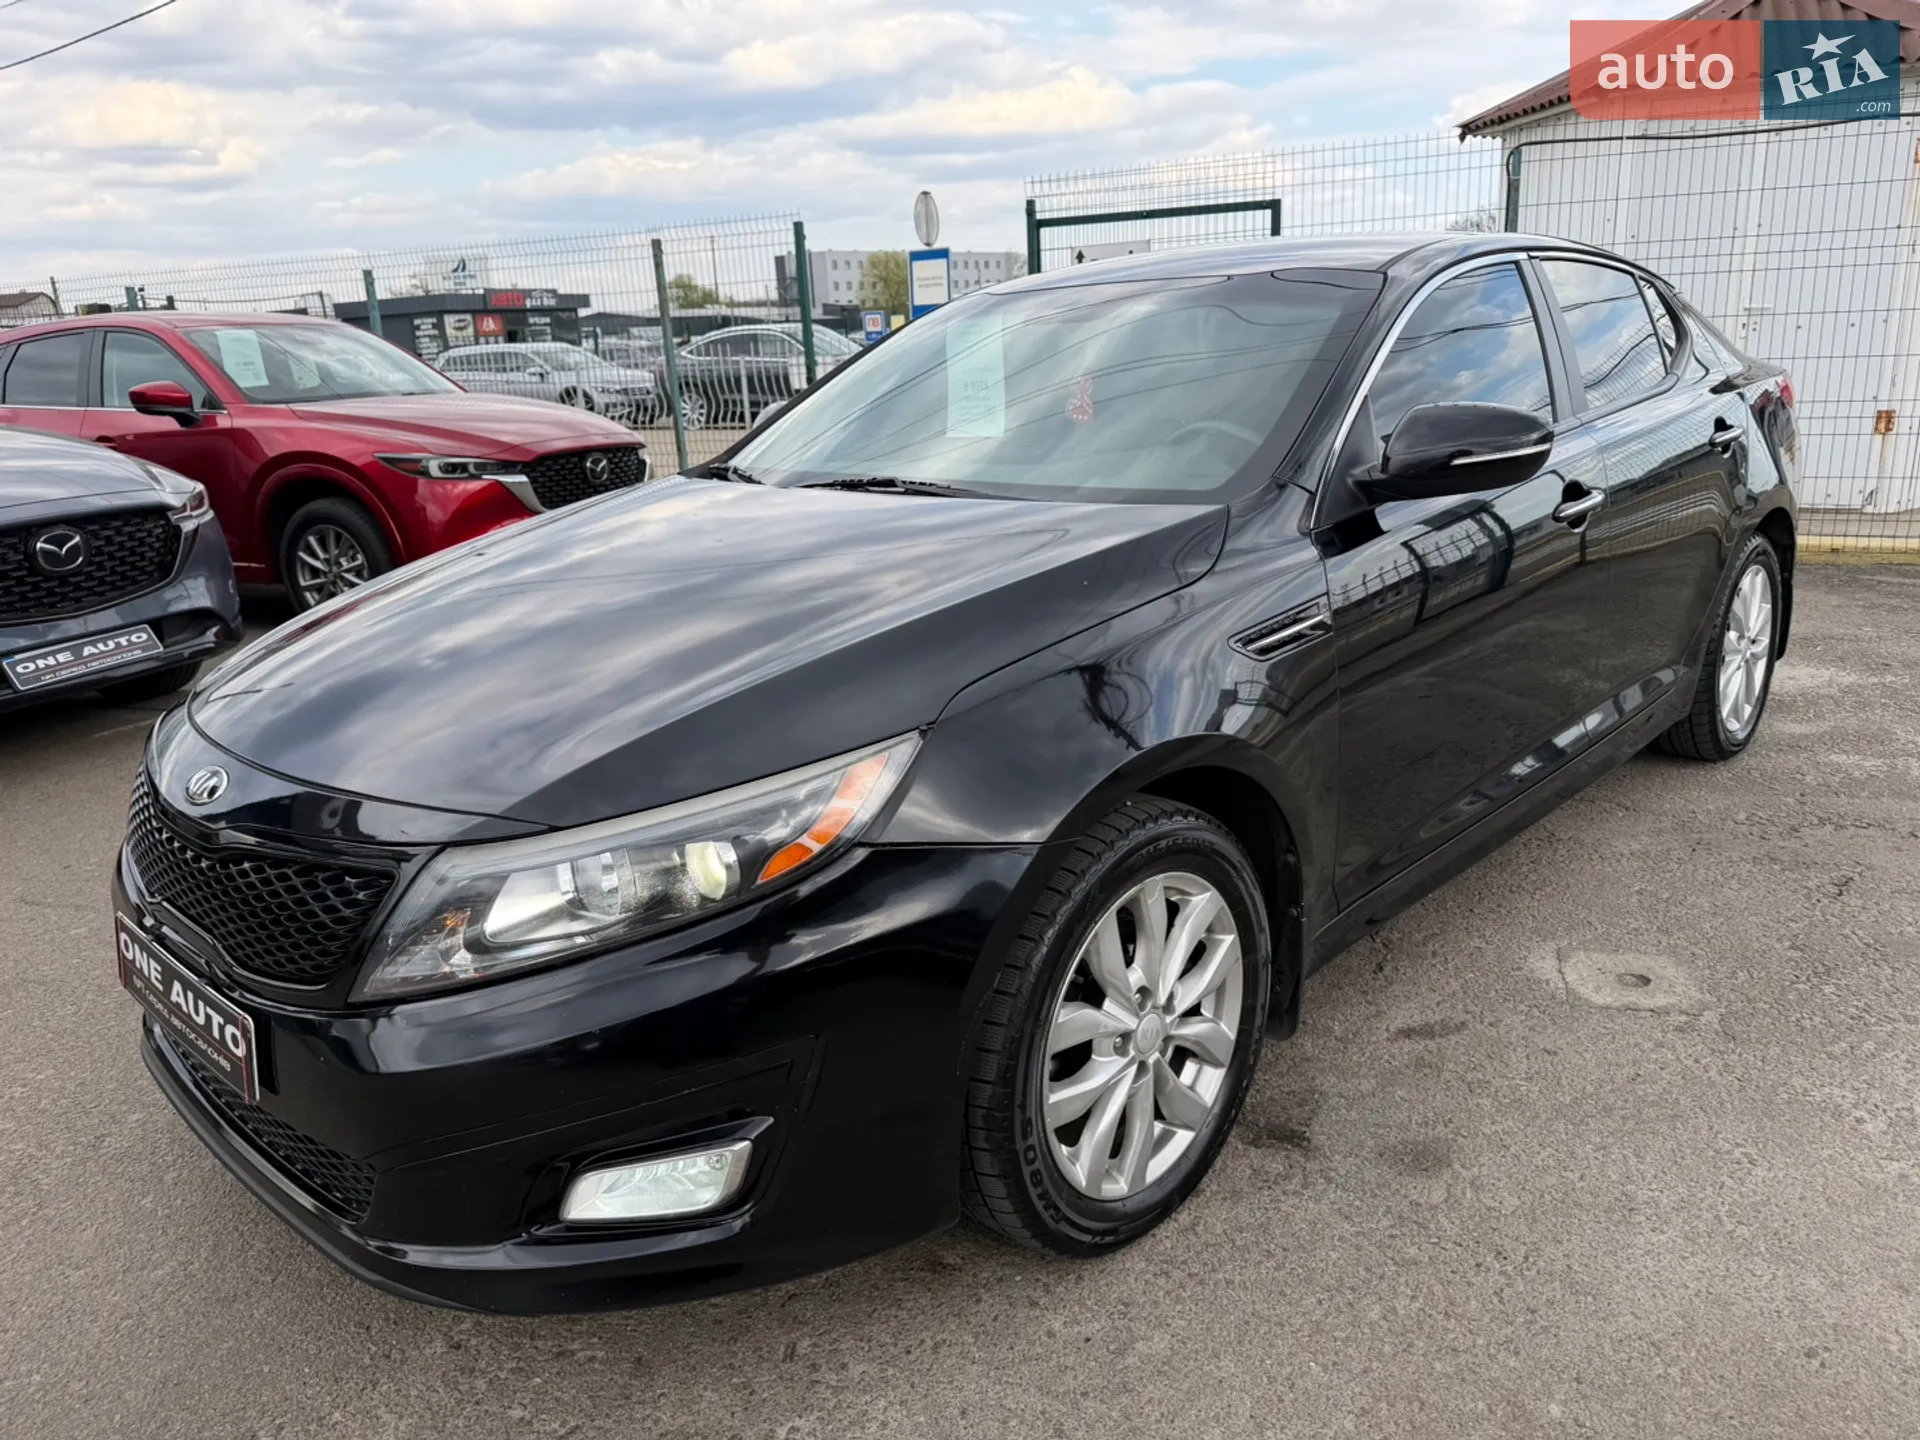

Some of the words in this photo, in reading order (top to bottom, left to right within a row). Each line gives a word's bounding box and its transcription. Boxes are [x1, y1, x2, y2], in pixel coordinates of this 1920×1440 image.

[15, 650, 75, 675] ONE
[82, 631, 149, 657] AUTO
[119, 931, 164, 992] ONE
[170, 979, 247, 1059] AUTO
